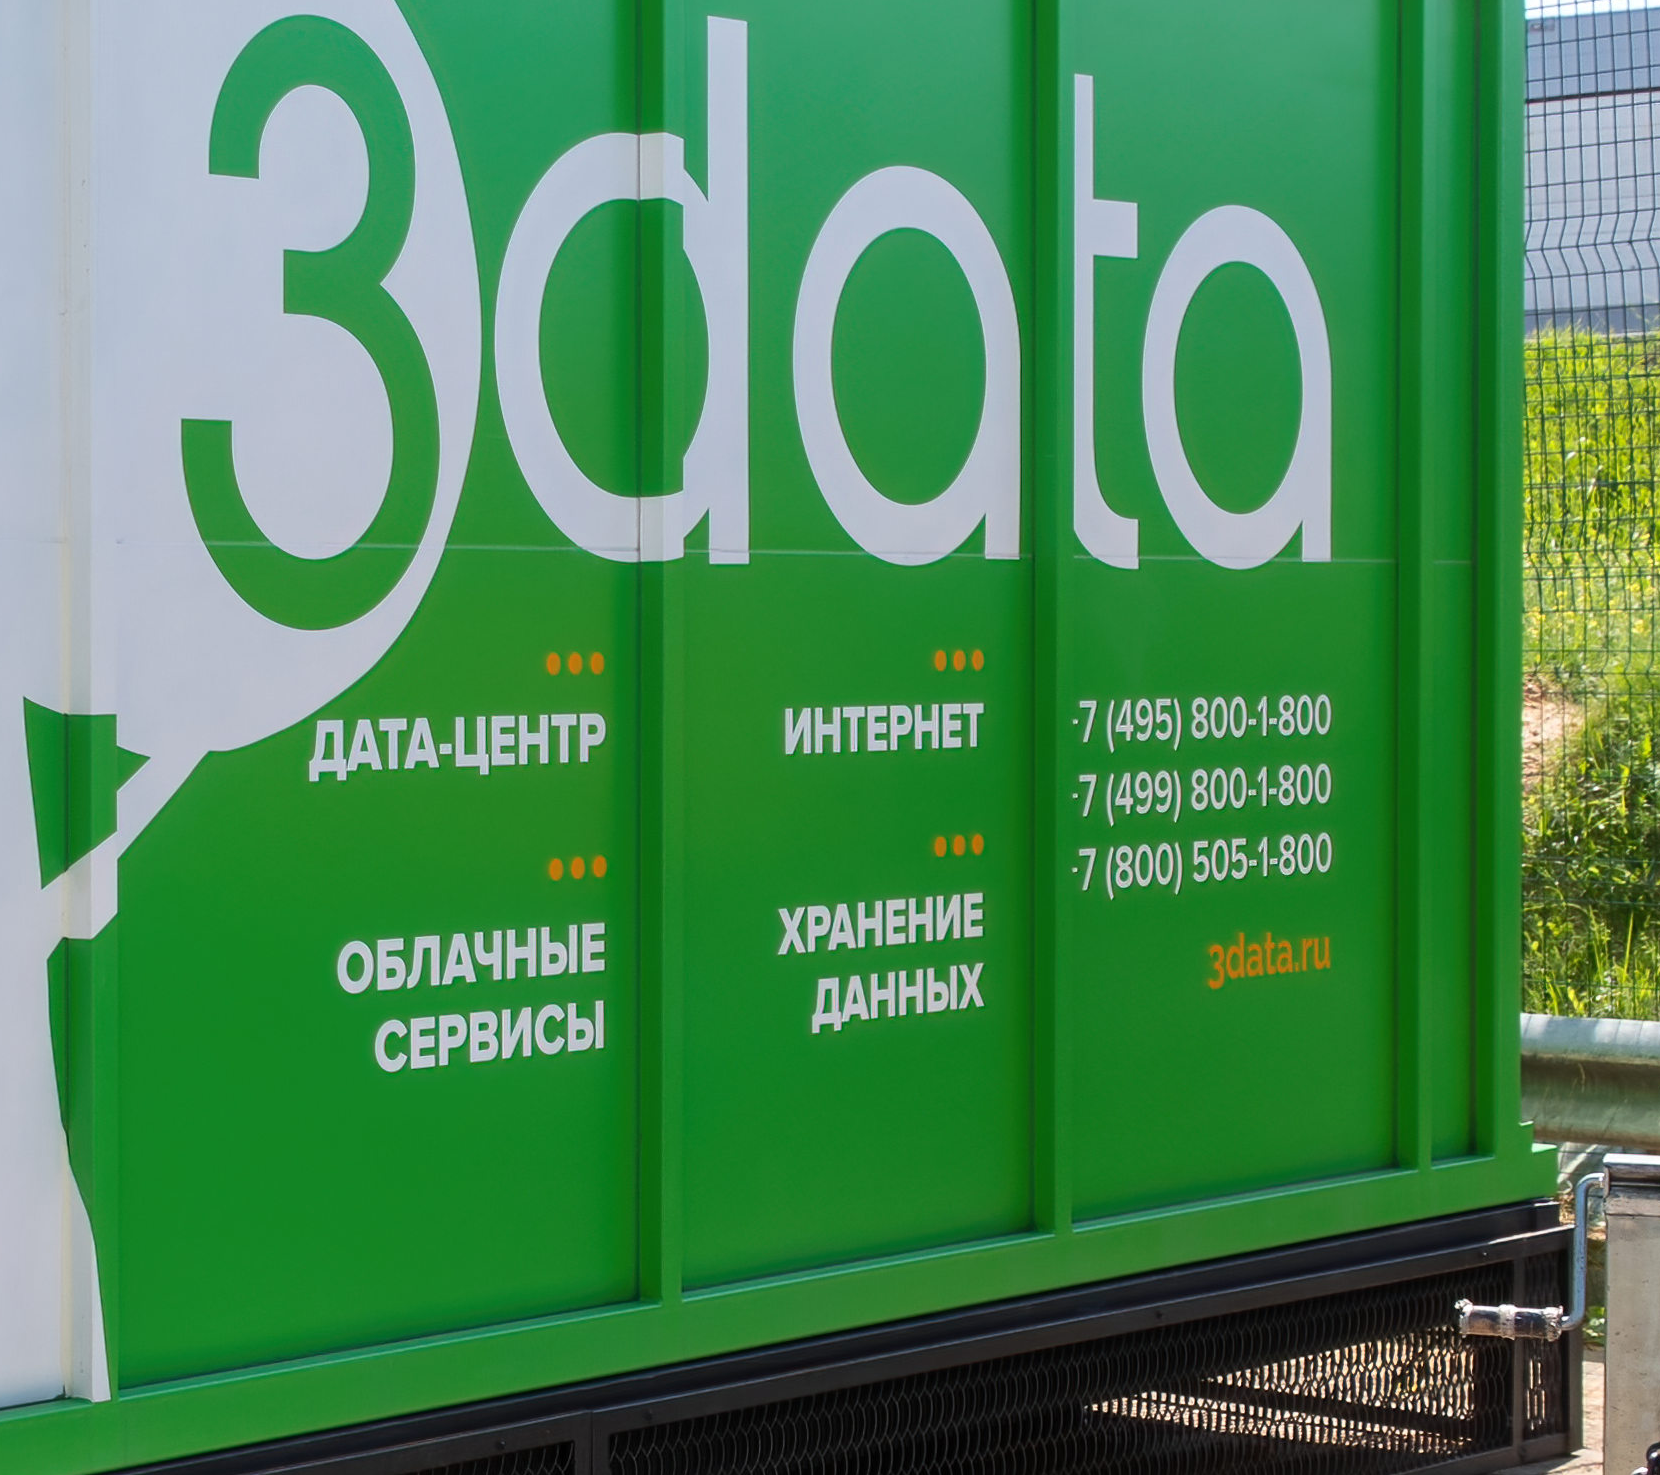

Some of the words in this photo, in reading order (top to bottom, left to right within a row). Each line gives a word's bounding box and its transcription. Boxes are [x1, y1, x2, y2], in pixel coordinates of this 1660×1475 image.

[180, 12, 1333, 633] 3data
[308, 713, 607, 783] ДАТА-ЦЕНТР
[783, 702, 985, 756] ИНТЕРНЕТ
[1106, 697, 1182, 754] (495)
[1191, 694, 1333, 740] 800-1-800
[1106, 770, 1182, 828] (499)
[1191, 763, 1333, 812] 800-1-800
[1106, 841, 1183, 901] (800)
[1192, 832, 1333, 883] 505-1-800
[336, 922, 607, 995] ОБЛАЧНЫЕ
[778, 892, 985, 956] ХРАНЕНИЕ
[1207, 931, 1332, 990] 3data.ru
[811, 963, 985, 1034] ДАННЫХ
[374, 1000, 606, 1074] СЕРВИСЫ
